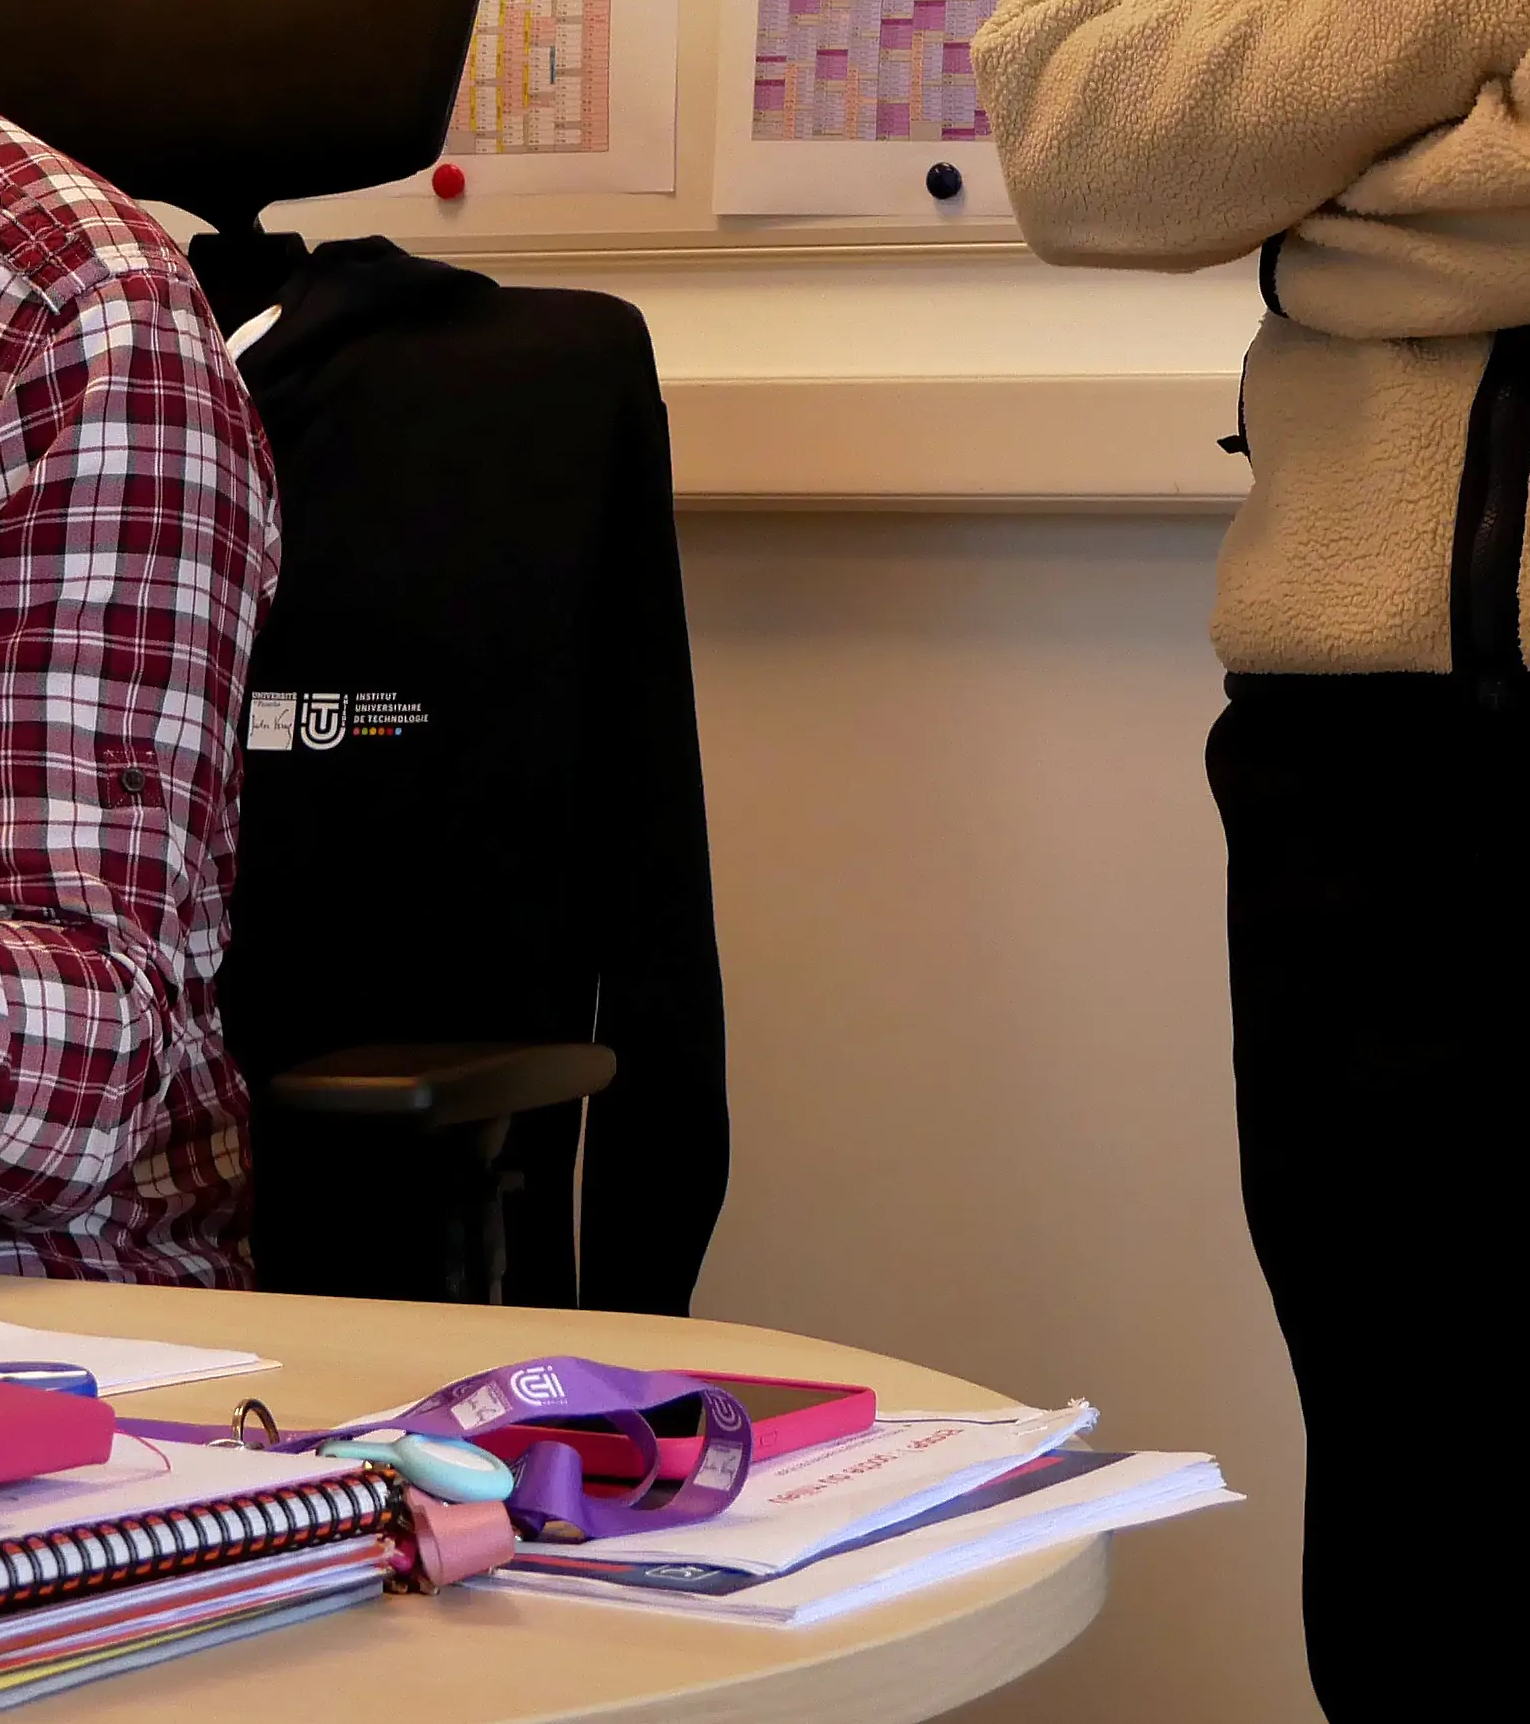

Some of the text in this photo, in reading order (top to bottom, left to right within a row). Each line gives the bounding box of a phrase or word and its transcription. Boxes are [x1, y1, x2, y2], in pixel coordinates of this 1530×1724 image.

[355, 703, 421, 712] UNIVERSITAIRE
[354, 715, 429, 724] DE TECHNOLOGIE
